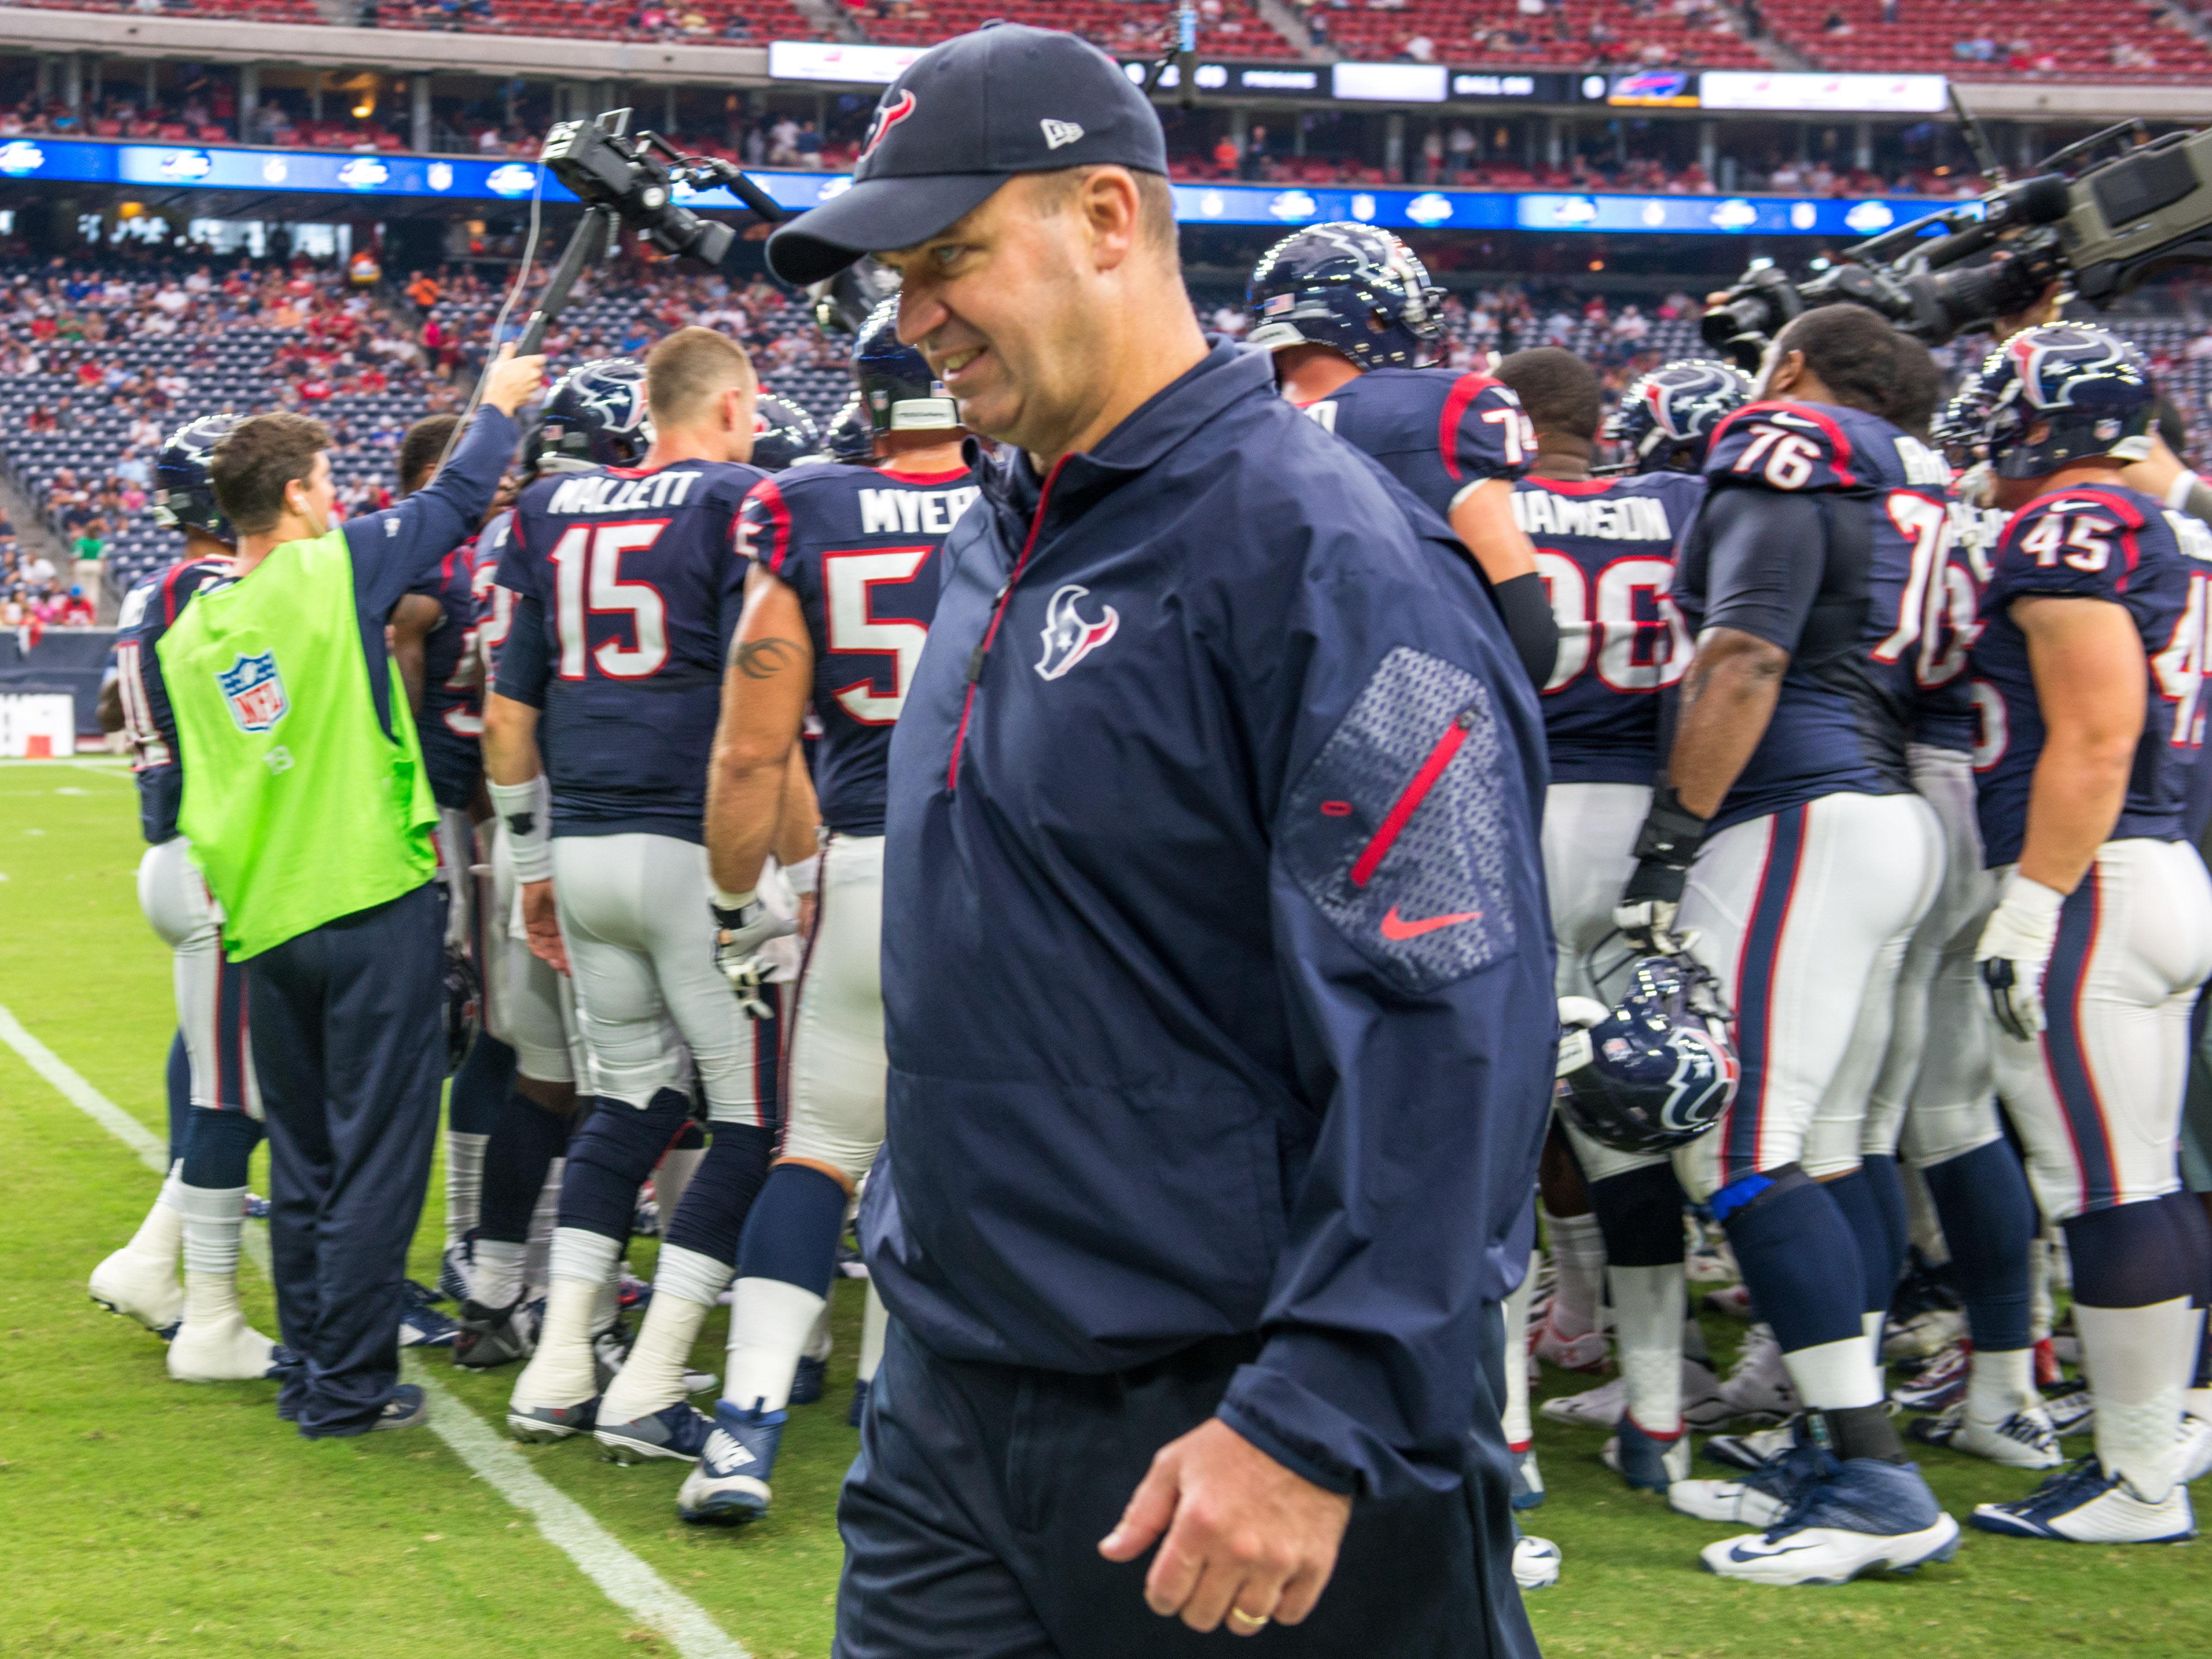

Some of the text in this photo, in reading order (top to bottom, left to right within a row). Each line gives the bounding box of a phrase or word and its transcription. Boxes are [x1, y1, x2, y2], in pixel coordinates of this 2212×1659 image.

[1732, 423, 1822, 491] 76
[547, 470, 704, 514] MALLETT
[858, 486, 982, 534] MYER
[2020, 512, 2120, 573] 45
[546, 518, 674, 681] 15
[821, 545, 940, 727] 5
